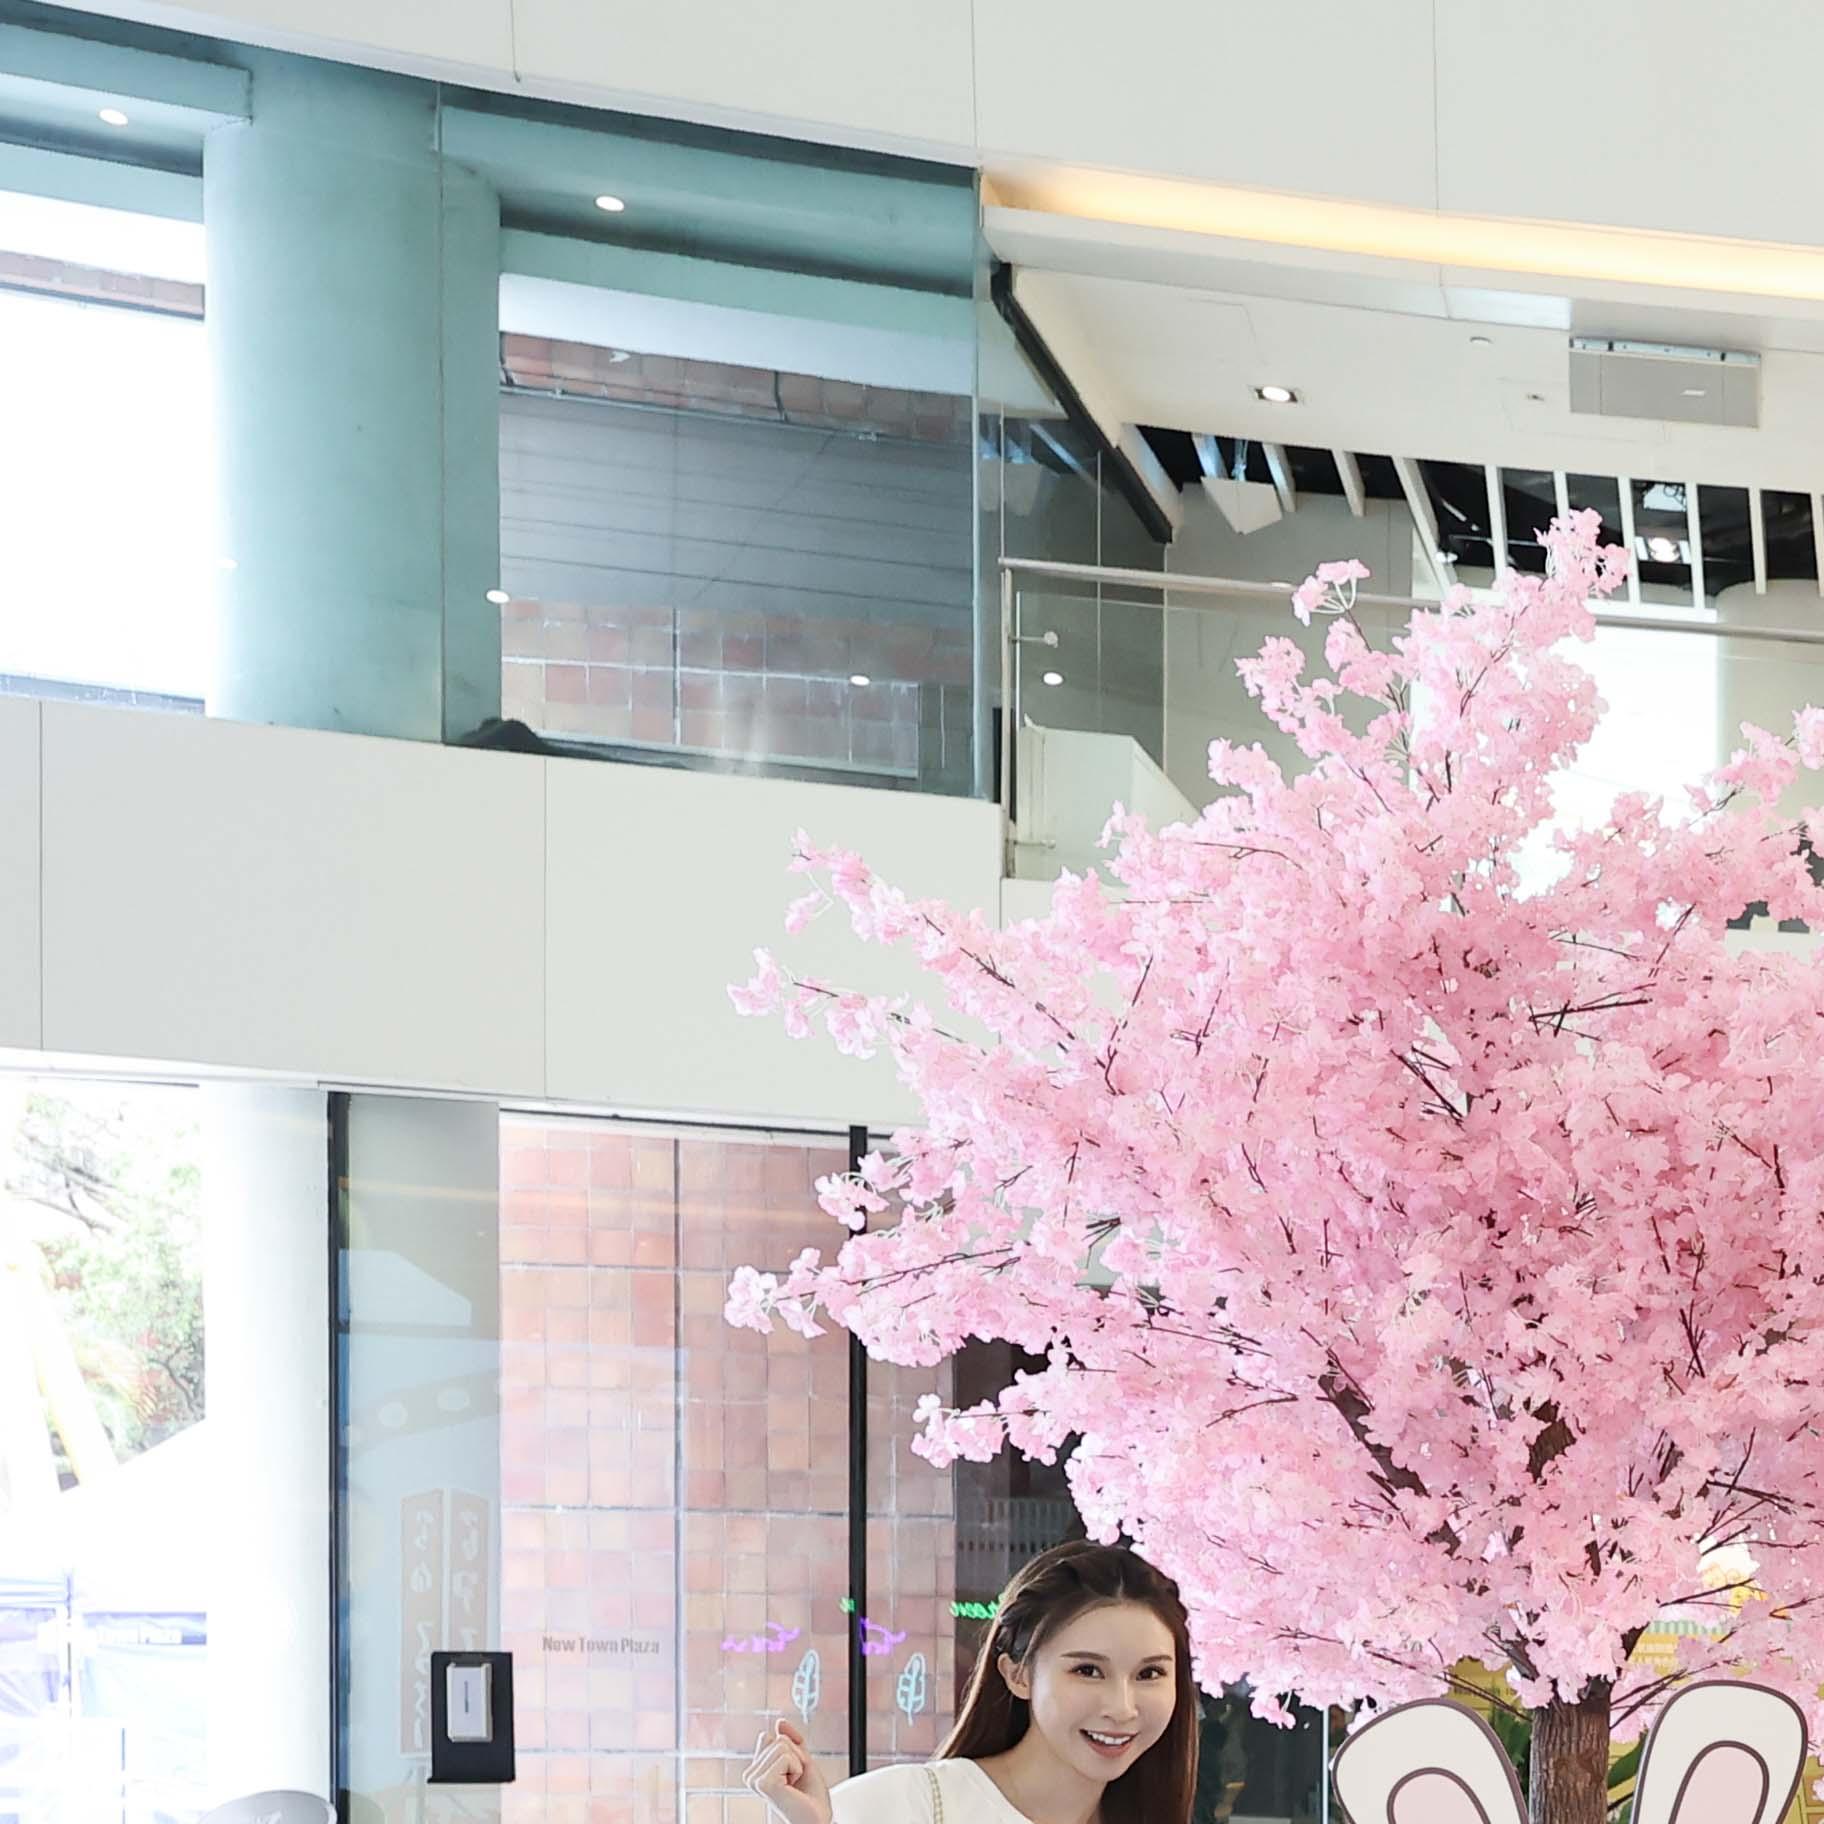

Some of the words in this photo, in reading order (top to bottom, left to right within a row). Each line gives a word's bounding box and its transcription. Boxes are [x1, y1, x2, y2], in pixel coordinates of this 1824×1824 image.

[542, 1636, 575, 1652] New
[579, 1637, 618, 1653] Town
[621, 1637, 660, 1654] Plaza
